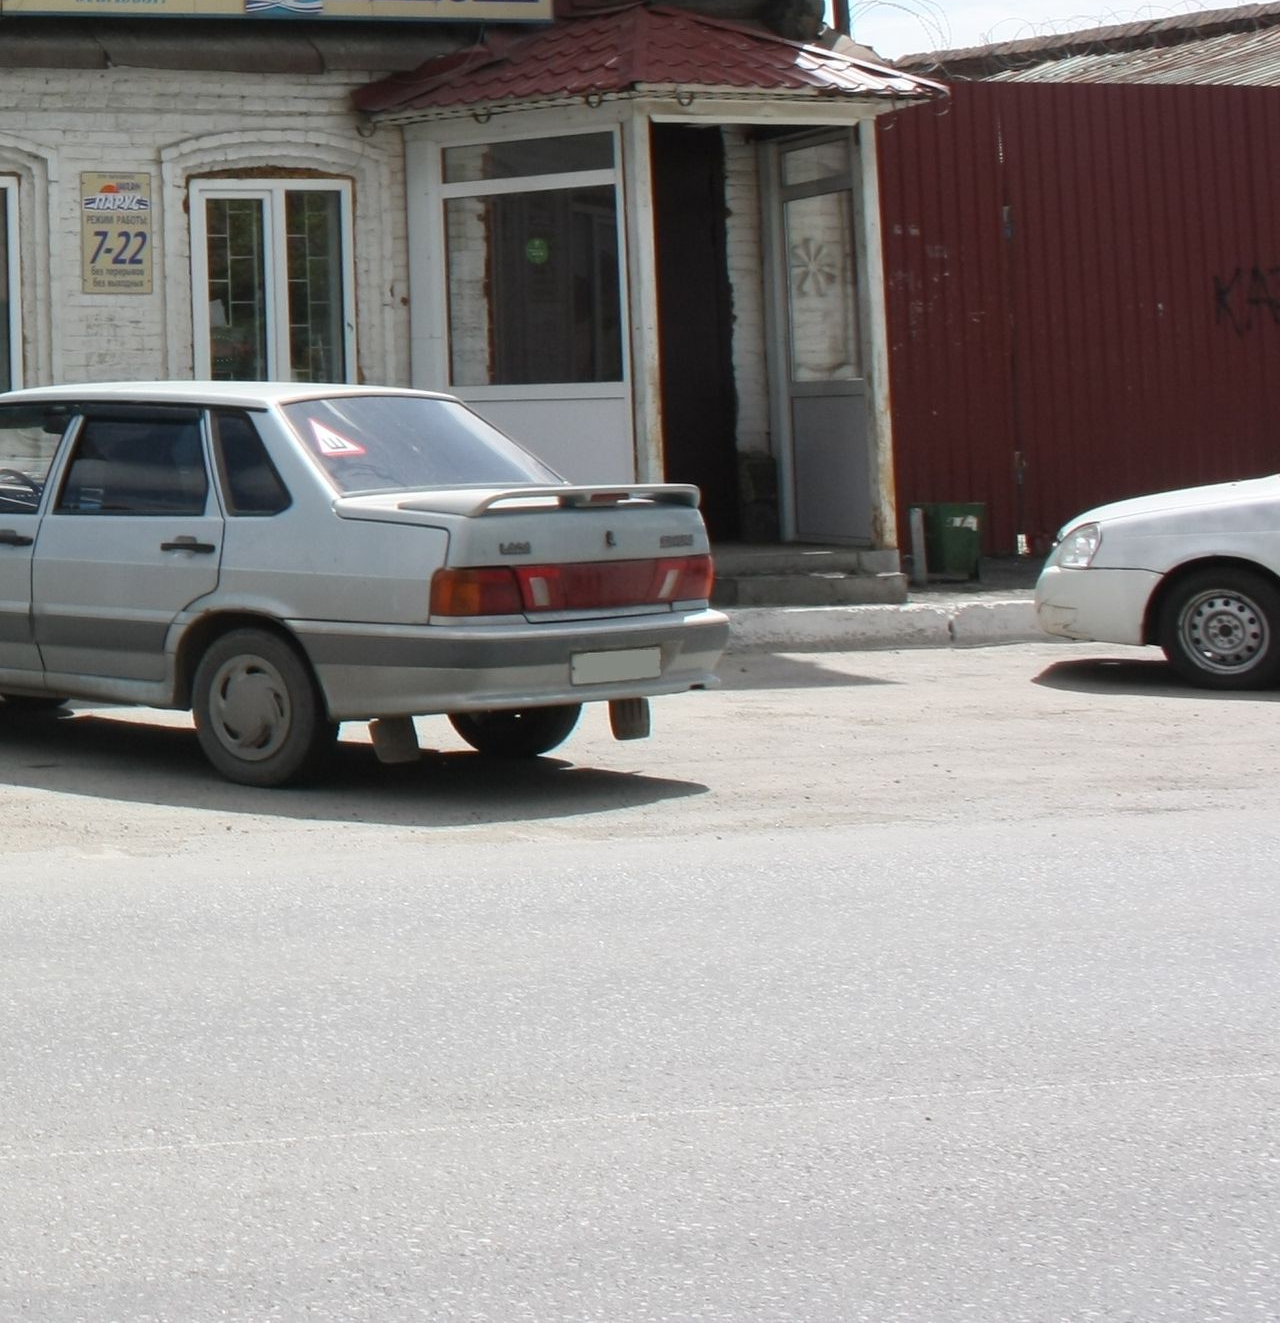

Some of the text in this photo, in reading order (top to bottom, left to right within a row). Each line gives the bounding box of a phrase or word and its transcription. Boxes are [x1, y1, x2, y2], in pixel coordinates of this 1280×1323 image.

[93, 195, 141, 212] ПАРУС
[86, 215, 114, 225] РЕЖИМ
[90, 230, 147, 264] 7-22
